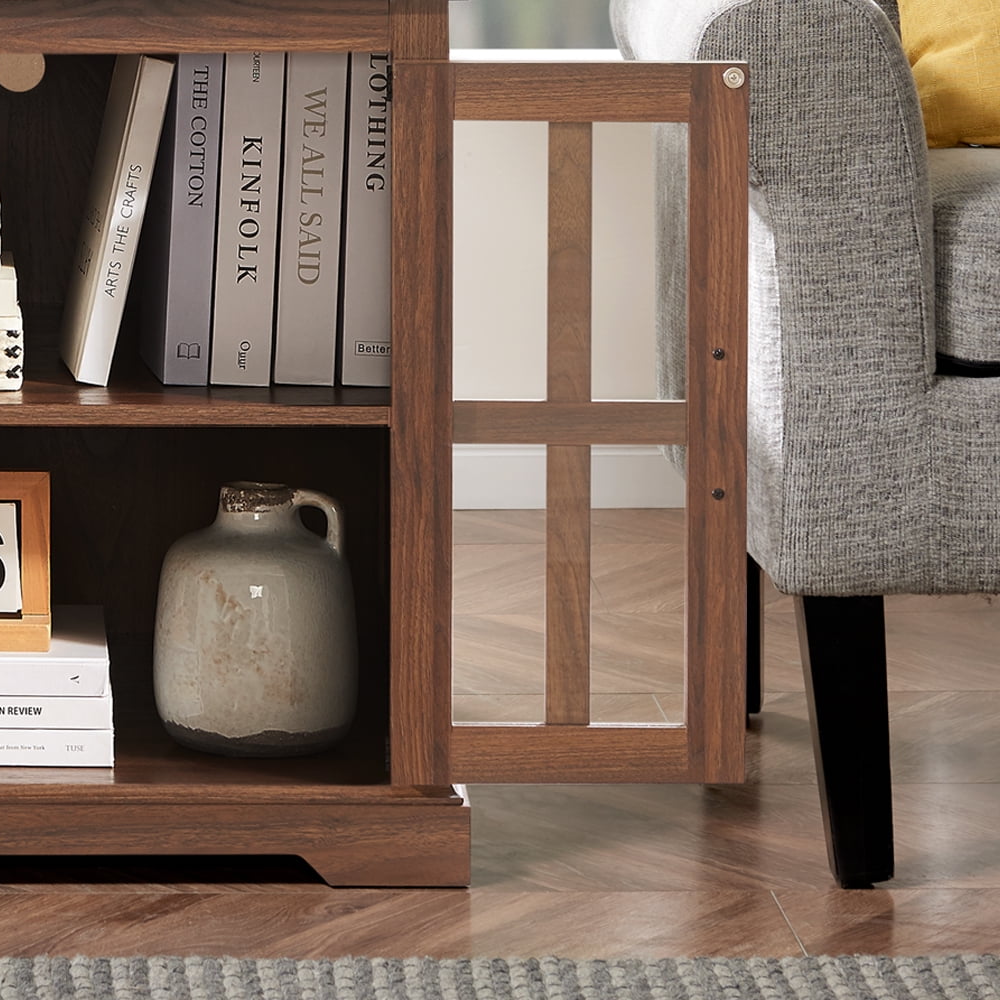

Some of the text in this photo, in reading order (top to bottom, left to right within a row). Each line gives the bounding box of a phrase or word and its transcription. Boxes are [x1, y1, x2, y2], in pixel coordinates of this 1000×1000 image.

[188, 66, 209, 208] THE COTTON
[298, 87, 328, 285] WE ALL SAID
[104, 164, 142, 298] ARTS THE CRAFTS
[236, 135, 263, 284] KINFOLK
[357, 343, 390, 354] Better
[7, 706, 42, 716] REVIEW
